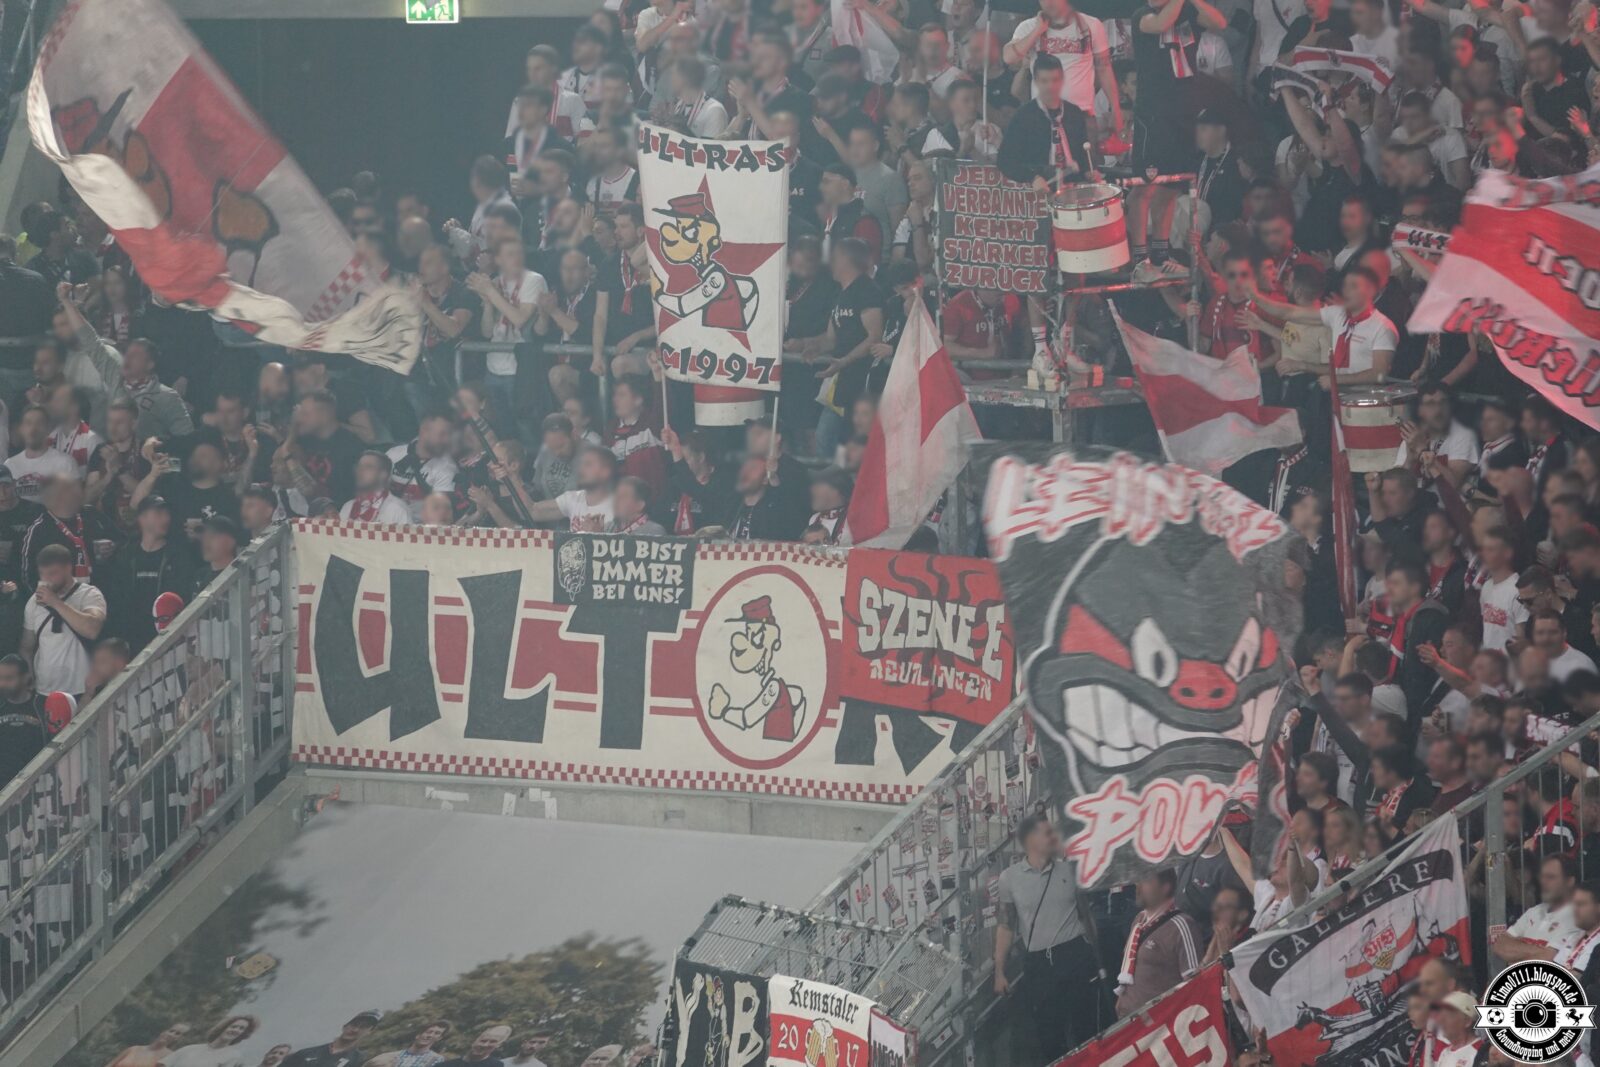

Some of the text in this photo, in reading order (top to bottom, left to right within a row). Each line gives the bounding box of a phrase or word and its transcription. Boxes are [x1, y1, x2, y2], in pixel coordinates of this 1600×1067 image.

[954, 165, 1034, 191] JED
[943, 183, 1048, 218] VERBANNTE
[955, 214, 1038, 241] KEHRT
[592, 540, 688, 561] DU BIST
[592, 560, 683, 586] IMMER
[592, 584, 685, 604] BEI UNS!
[858, 578, 977, 662] SZENE
[788, 979, 859, 1025] Remstaler
[777, 1022, 799, 1051] 20
